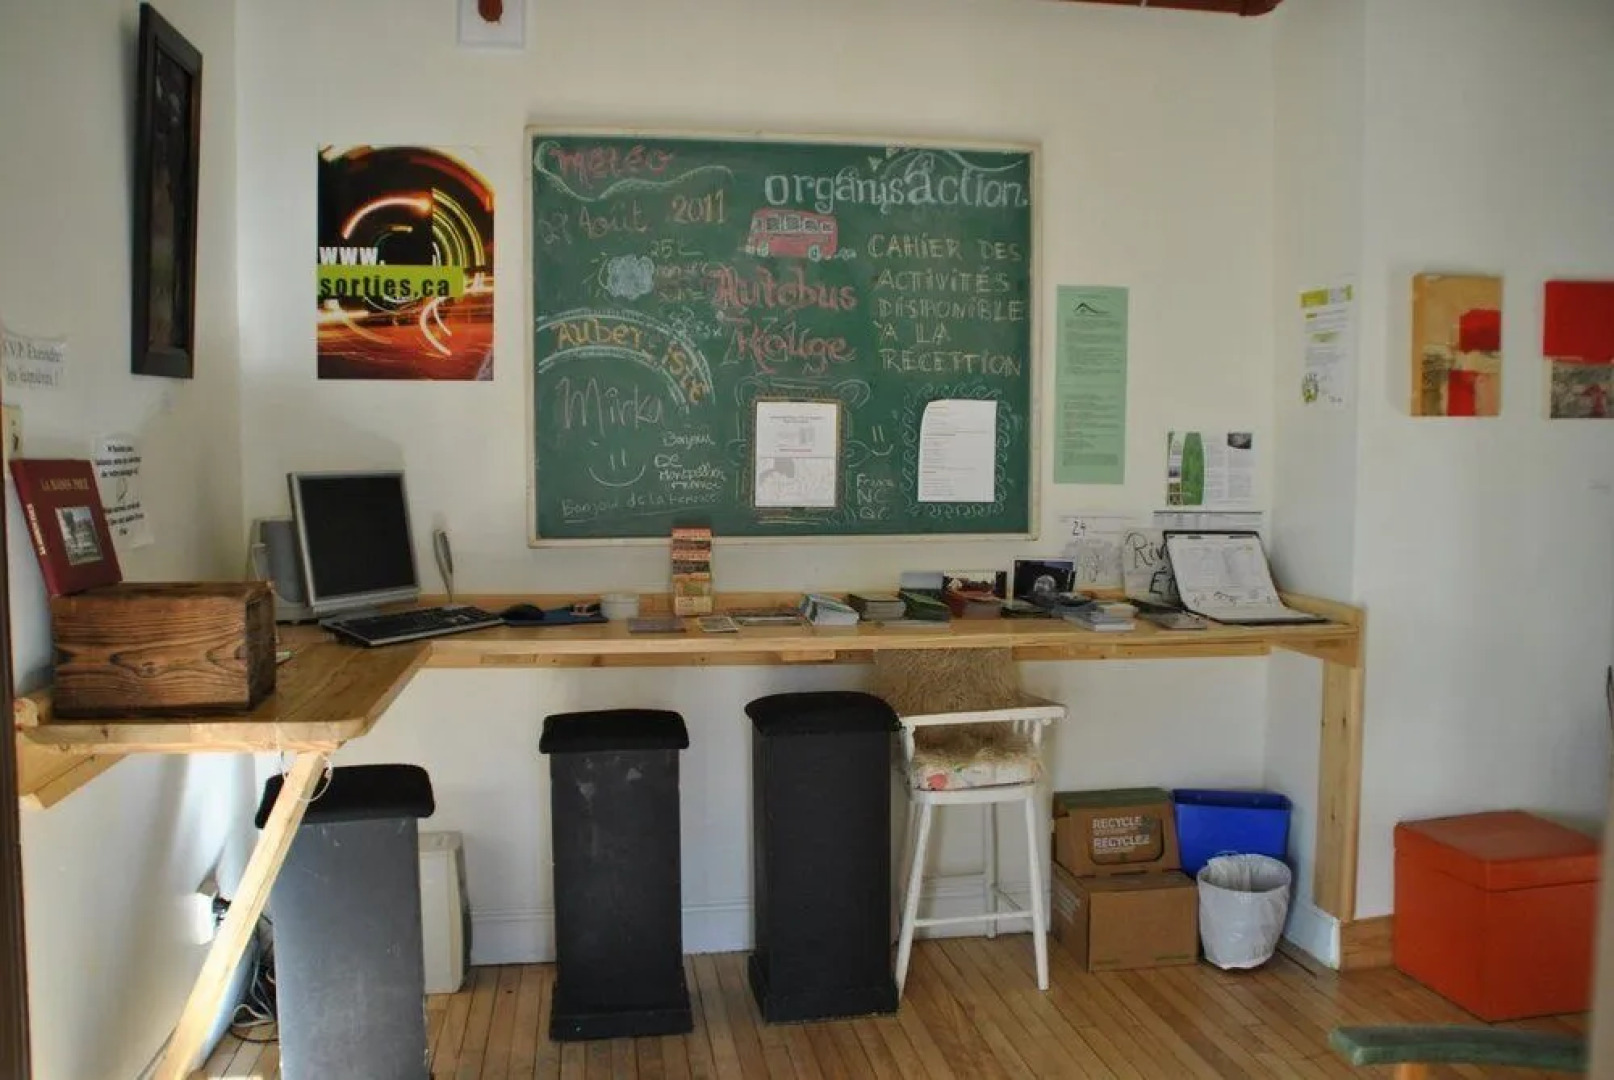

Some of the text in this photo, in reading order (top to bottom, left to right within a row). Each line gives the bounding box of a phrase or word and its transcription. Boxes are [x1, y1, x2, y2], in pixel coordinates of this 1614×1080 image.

[319, 246, 386, 266] www.
[319, 275, 451, 299] sorties.ca
[914, 320, 953, 346] LA
[1092, 816, 1142, 829] RECYCLE
